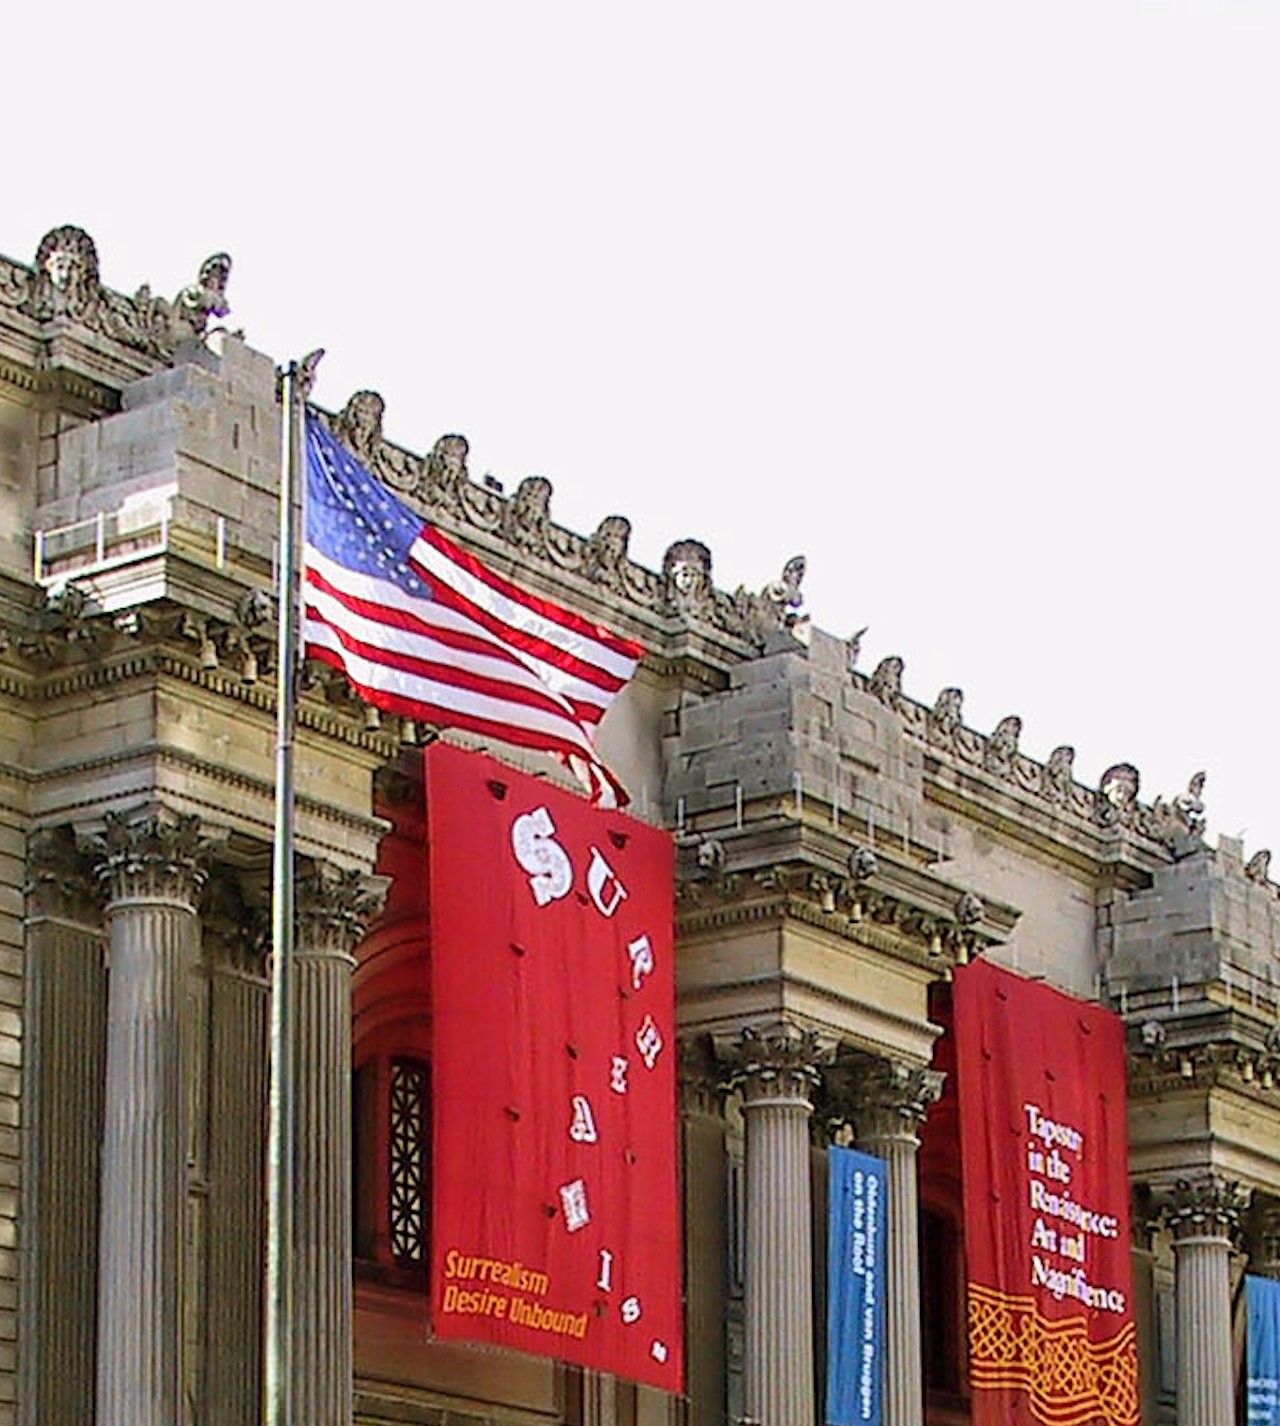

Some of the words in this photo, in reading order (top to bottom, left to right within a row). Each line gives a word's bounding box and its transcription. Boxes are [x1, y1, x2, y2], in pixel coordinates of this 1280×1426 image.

[1028, 1142, 1045, 1174] in
[1047, 1150, 1070, 1184] the
[853, 1171, 864, 1196] on
[853, 1198, 865, 1229] the
[852, 1231, 866, 1275] Roof
[445, 1250, 549, 1296] Surrealism
[865, 1269, 875, 1305] and
[443, 1286, 508, 1319] Desire
[509, 1297, 588, 1340] Unbound
[864, 1306, 874, 1340] van
